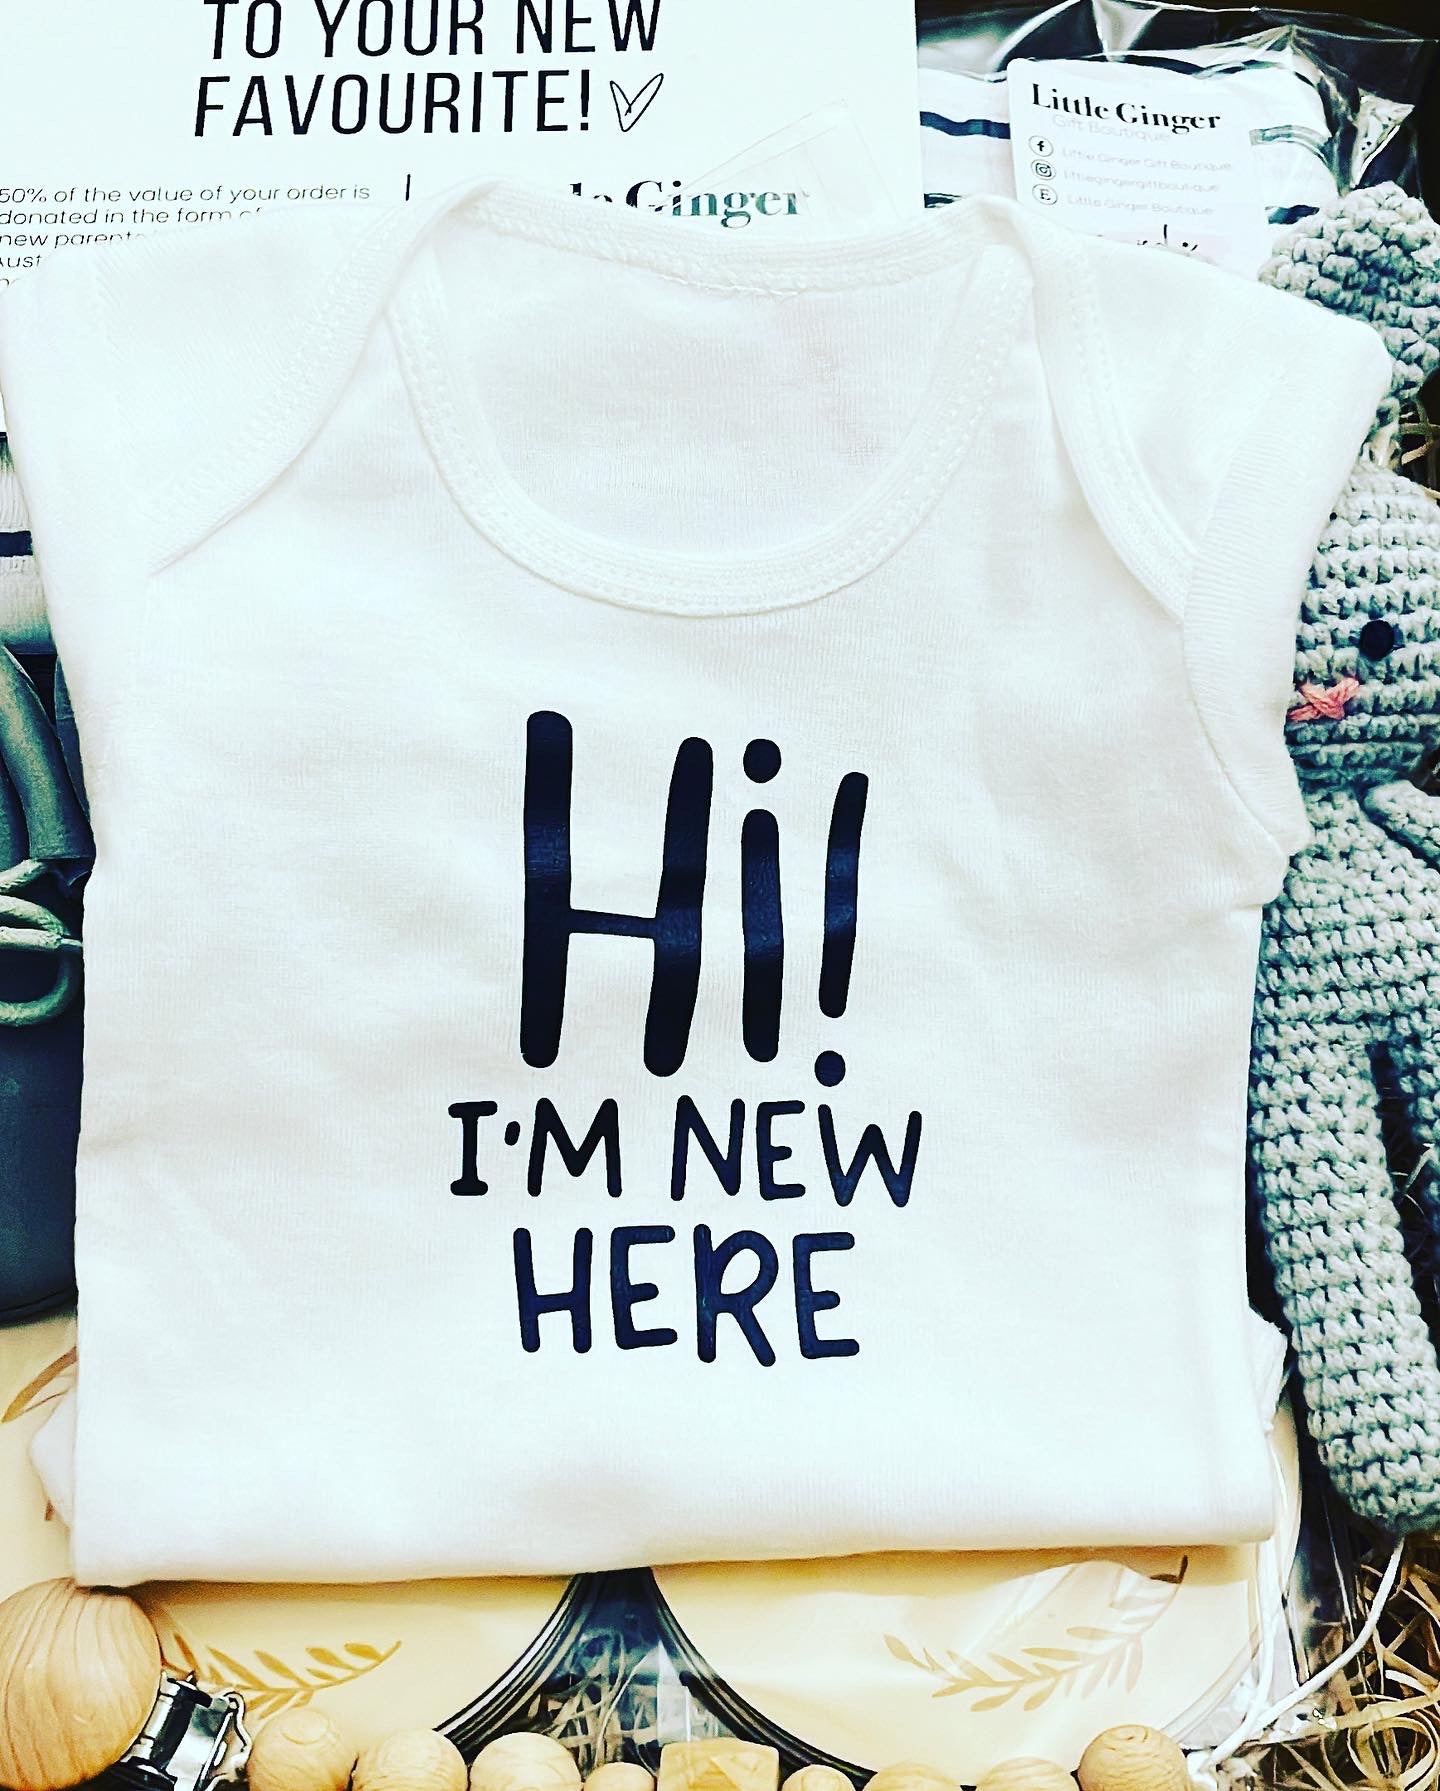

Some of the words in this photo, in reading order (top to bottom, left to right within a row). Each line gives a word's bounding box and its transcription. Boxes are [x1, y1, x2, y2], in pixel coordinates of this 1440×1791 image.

[204, 0, 281, 59] TO
[314, 0, 483, 57] YOUR
[517, 0, 660, 54] NEW
[195, 70, 590, 137] FAVOURITE!
[1032, 83, 1109, 119] Little
[1115, 102, 1221, 135] Ginger
[1052, 113, 1086, 130] Gift
[1088, 121, 1171, 143] Boutique
[1062, 146, 1095, 160] Little
[1097, 152, 1141, 168] Ginger
[0, 188, 47, 203] 50%
[54, 187, 78, 203] of
[85, 187, 121, 202] the
[129, 187, 193, 202] value
[200, 185, 223, 201] of
[230, 188, 280, 204] your
[287, 185, 346, 200] order
[353, 184, 370, 199] is
[0, 209, 98, 225] donated
[105, 209, 124, 223] in
[133, 208, 169, 223] the
[178, 207, 231, 223] form
[626, 181, 801, 228] Ginger
[1067, 194, 1100, 208] Little
[54, 231, 146, 249] parent
[519, 711, 869, 1087] Hi!
[448, 1098, 622, 1198] I'M
[671, 1095, 922, 1207] NEW
[513, 1224, 859, 1367] HERE
